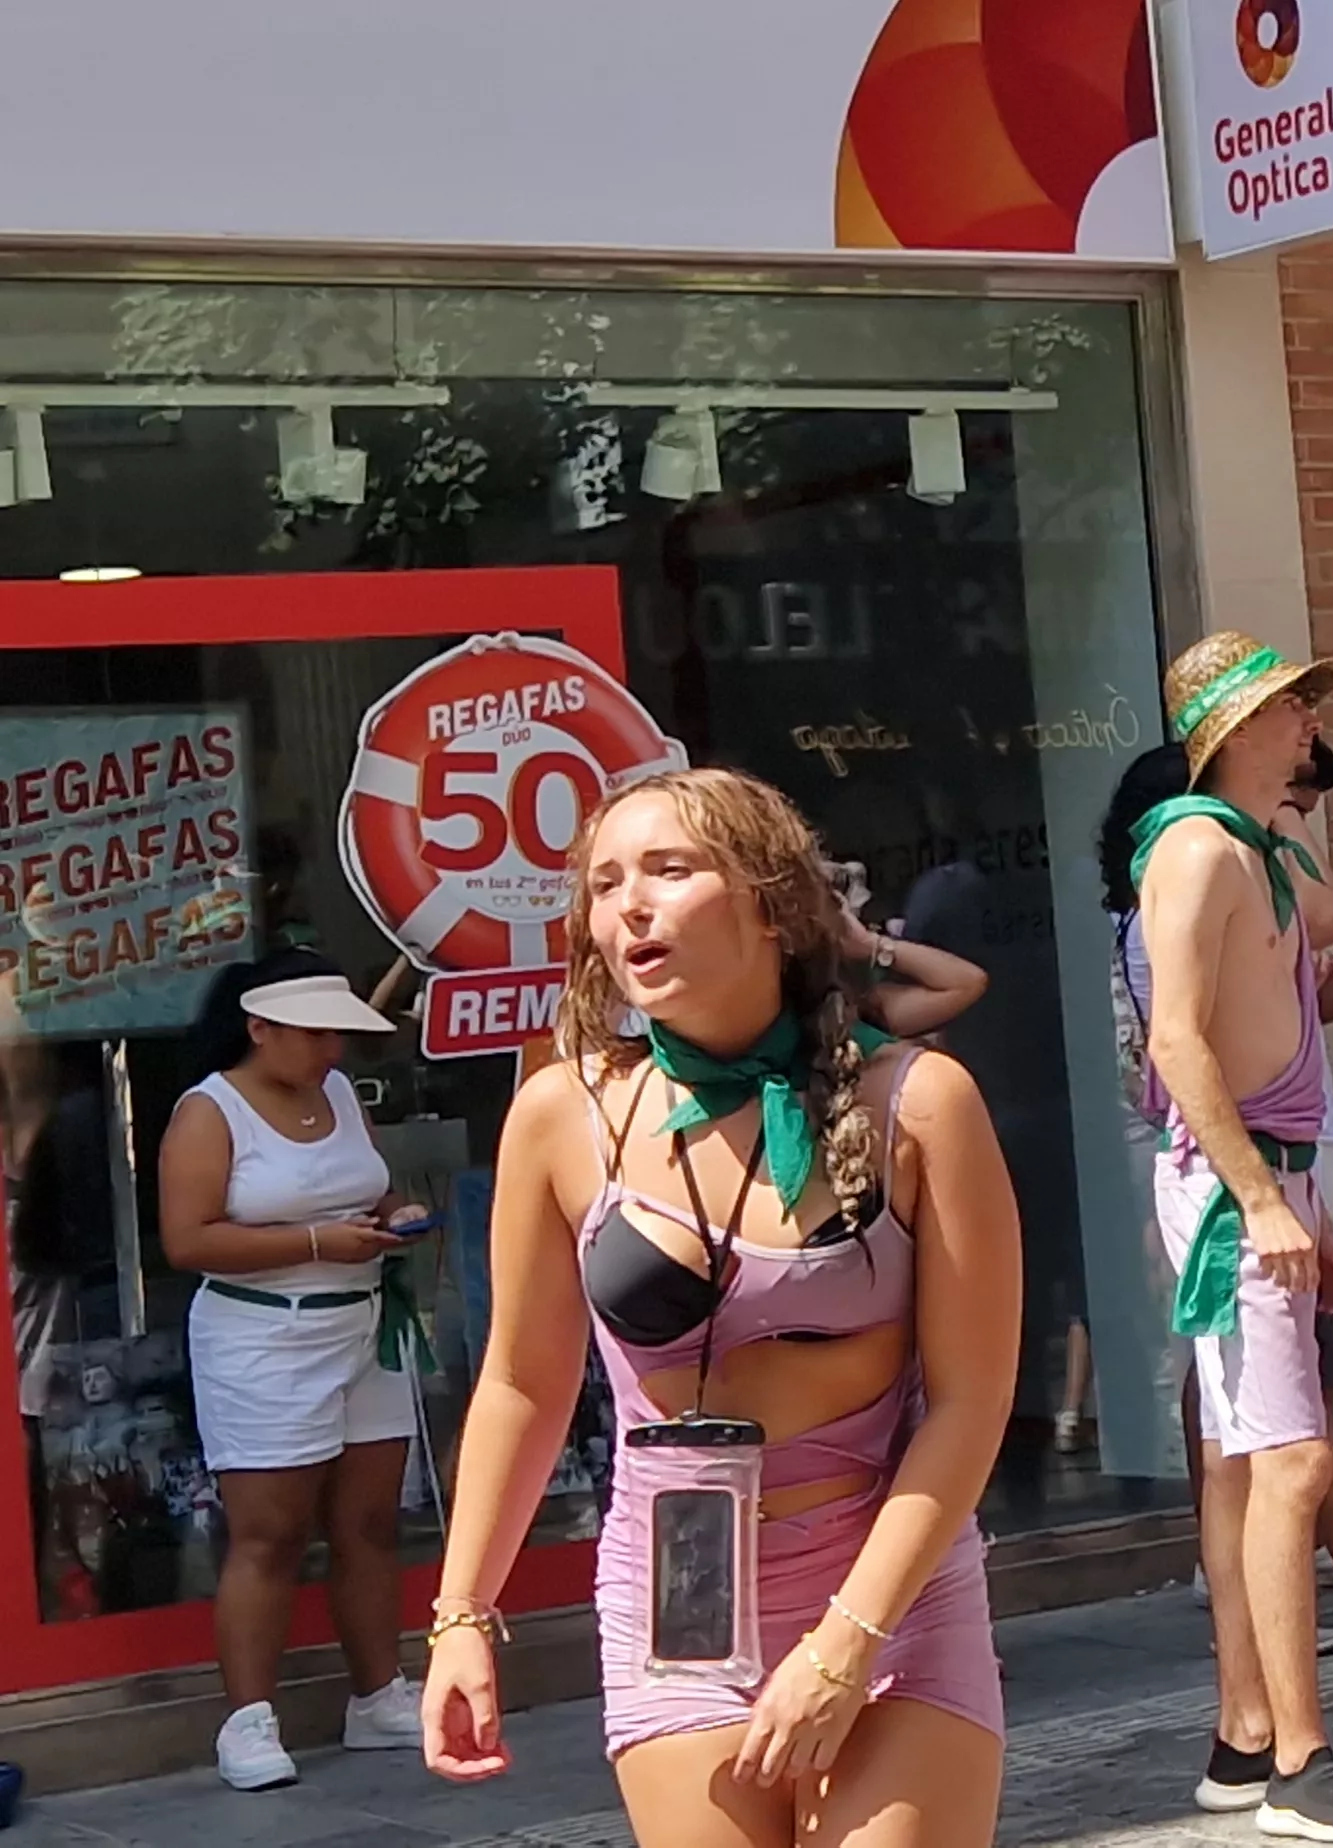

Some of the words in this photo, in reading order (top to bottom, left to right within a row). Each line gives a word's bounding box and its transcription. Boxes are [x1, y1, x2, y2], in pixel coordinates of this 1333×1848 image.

[1228, 152, 1329, 221] Optica
[428, 675, 586, 740] REGAFAS
[418, 751, 602, 872] 50
[447, 982, 562, 1038] REM
